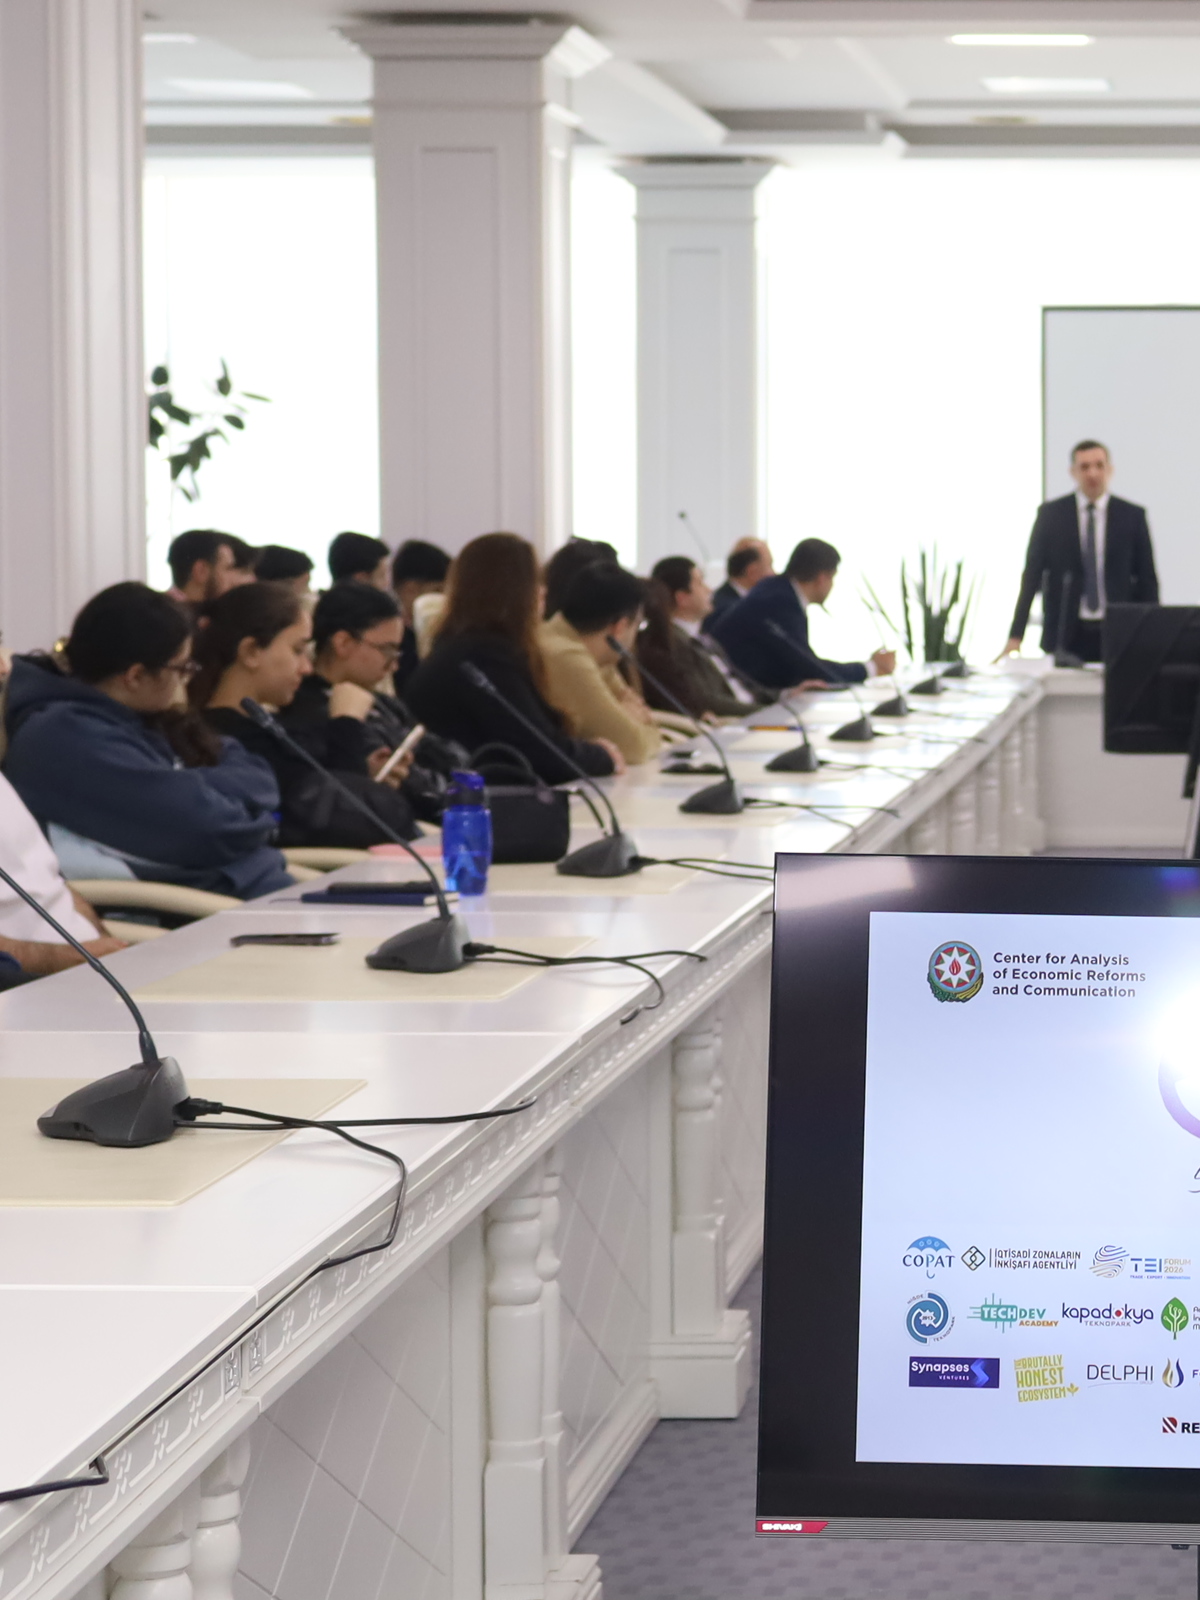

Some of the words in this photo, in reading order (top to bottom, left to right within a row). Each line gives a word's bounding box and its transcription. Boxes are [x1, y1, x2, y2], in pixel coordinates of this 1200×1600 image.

[993, 952, 1042, 964] Center
[1045, 952, 1066, 965] for
[1070, 953, 1129, 968] Analysis
[993, 968, 1007, 980] of
[1012, 969, 1082, 981] Economic
[1087, 970, 1146, 982] Reforms
[992, 984, 1018, 996] and
[1023, 985, 1136, 998] Communication
[902, 1253, 956, 1269] COPAT
[994, 1248, 1031, 1259] İQTİSADİ
[1033, 1250, 1081, 1260] ZONALARIN
[994, 1259, 1031, 1270] İNKİŞAFI
[1032, 1260, 1077, 1270] AGENTLİYİ
[1164, 1258, 1191, 1266] FORUM
[1062, 1302, 1154, 1324] kapadokya
[911, 1361, 970, 1375] Synapses
[1021, 1354, 1063, 1369] BRUTALLY
[1015, 1366, 1064, 1388] HONEST
[1087, 1364, 1154, 1381] DELPHI
[1017, 1386, 1067, 1403] ECOSYSTEM
